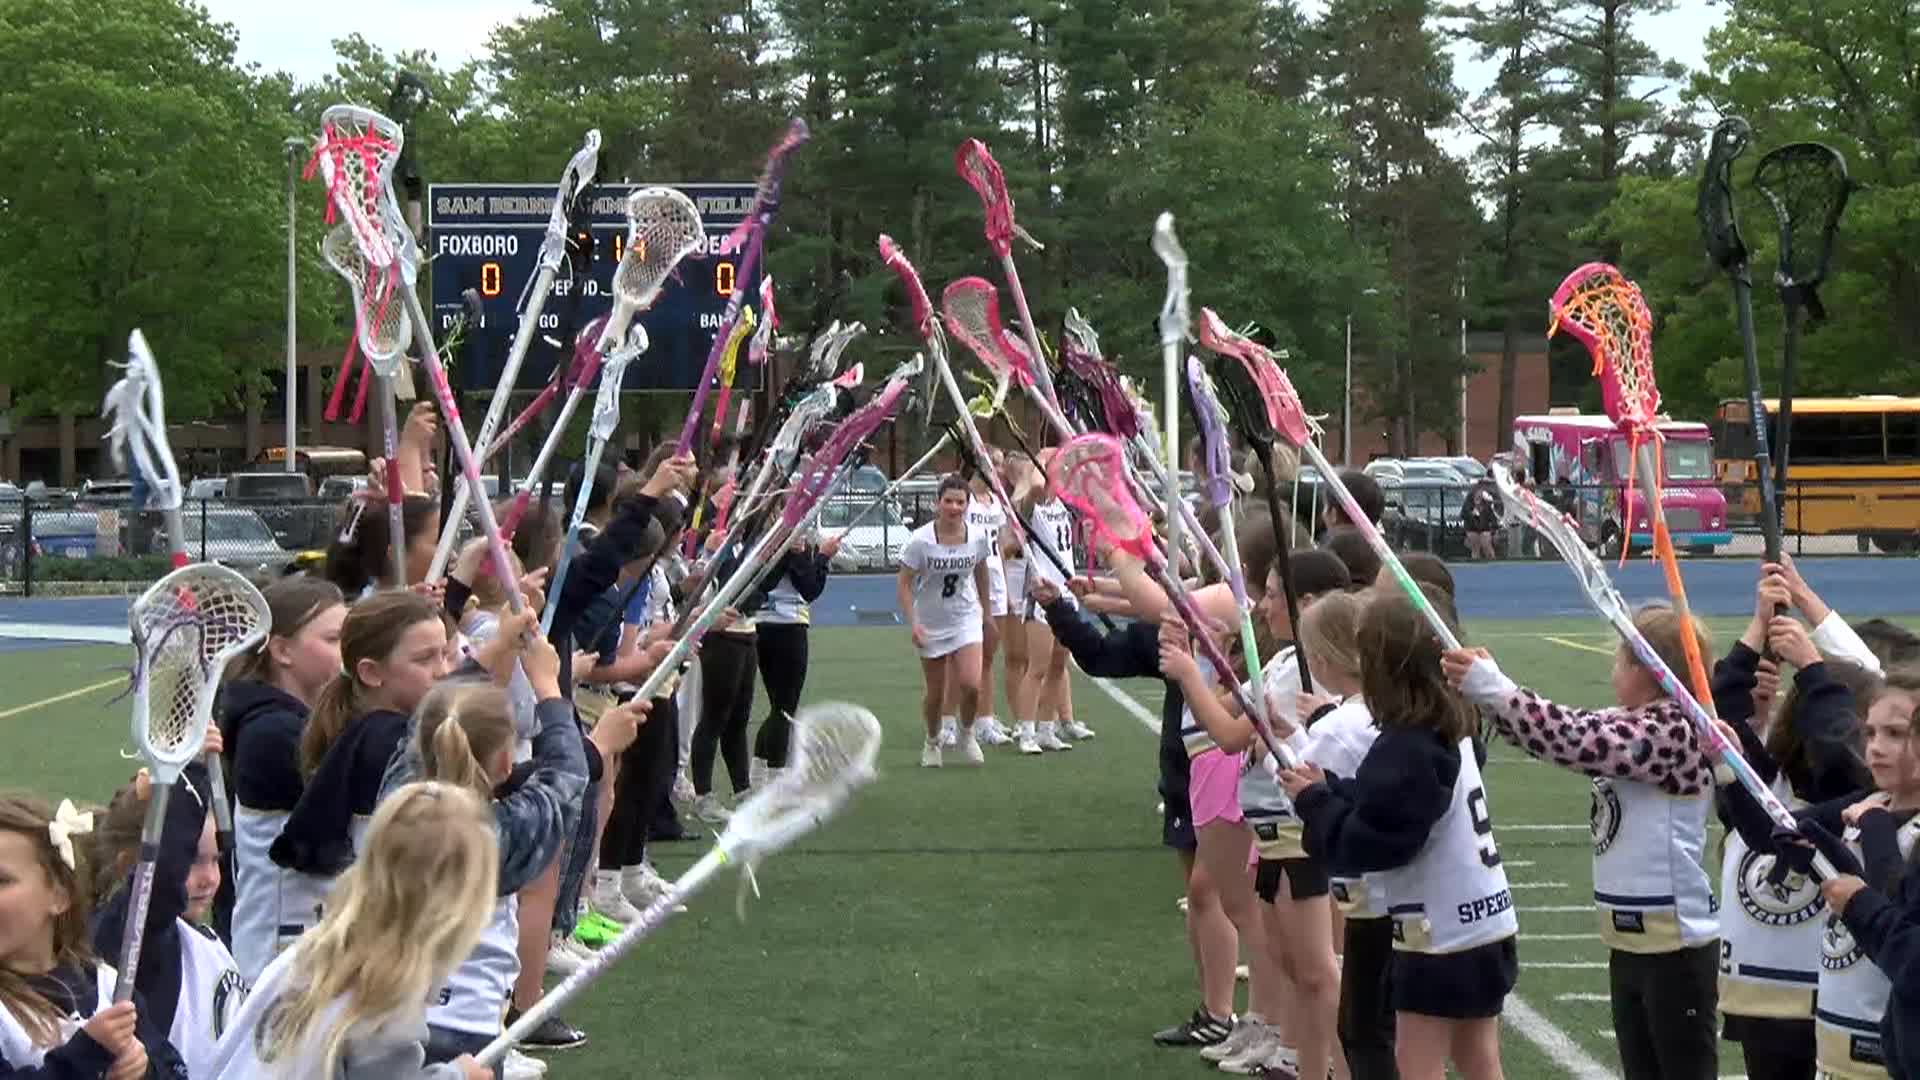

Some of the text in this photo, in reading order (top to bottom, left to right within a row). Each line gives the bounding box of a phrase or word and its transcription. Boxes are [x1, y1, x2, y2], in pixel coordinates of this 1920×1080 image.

[437, 197, 485, 215] SAM
[439, 235, 518, 255] FOXBORO
[482, 262, 501, 297] 0
[716, 262, 735, 295] 0
[539, 314, 559, 328] GO
[942, 573, 959, 598] 8
